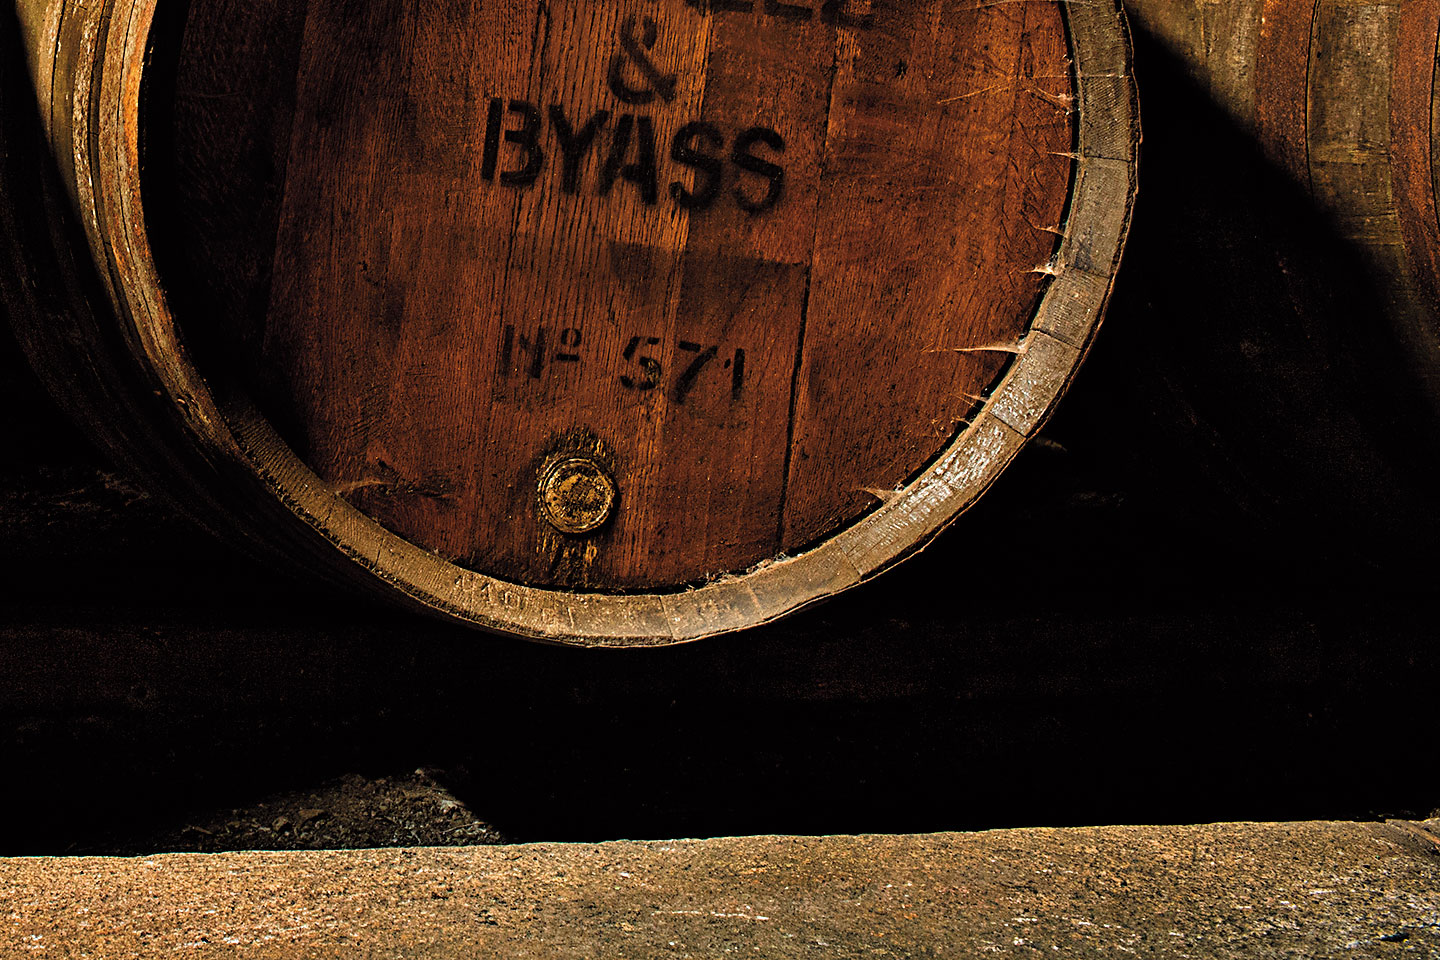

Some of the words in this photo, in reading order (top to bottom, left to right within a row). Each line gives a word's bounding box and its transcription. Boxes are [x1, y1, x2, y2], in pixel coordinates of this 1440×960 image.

[610, 14, 676, 105] &
[482, 97, 786, 212] BYASS
[620, 336, 746, 405] 571
